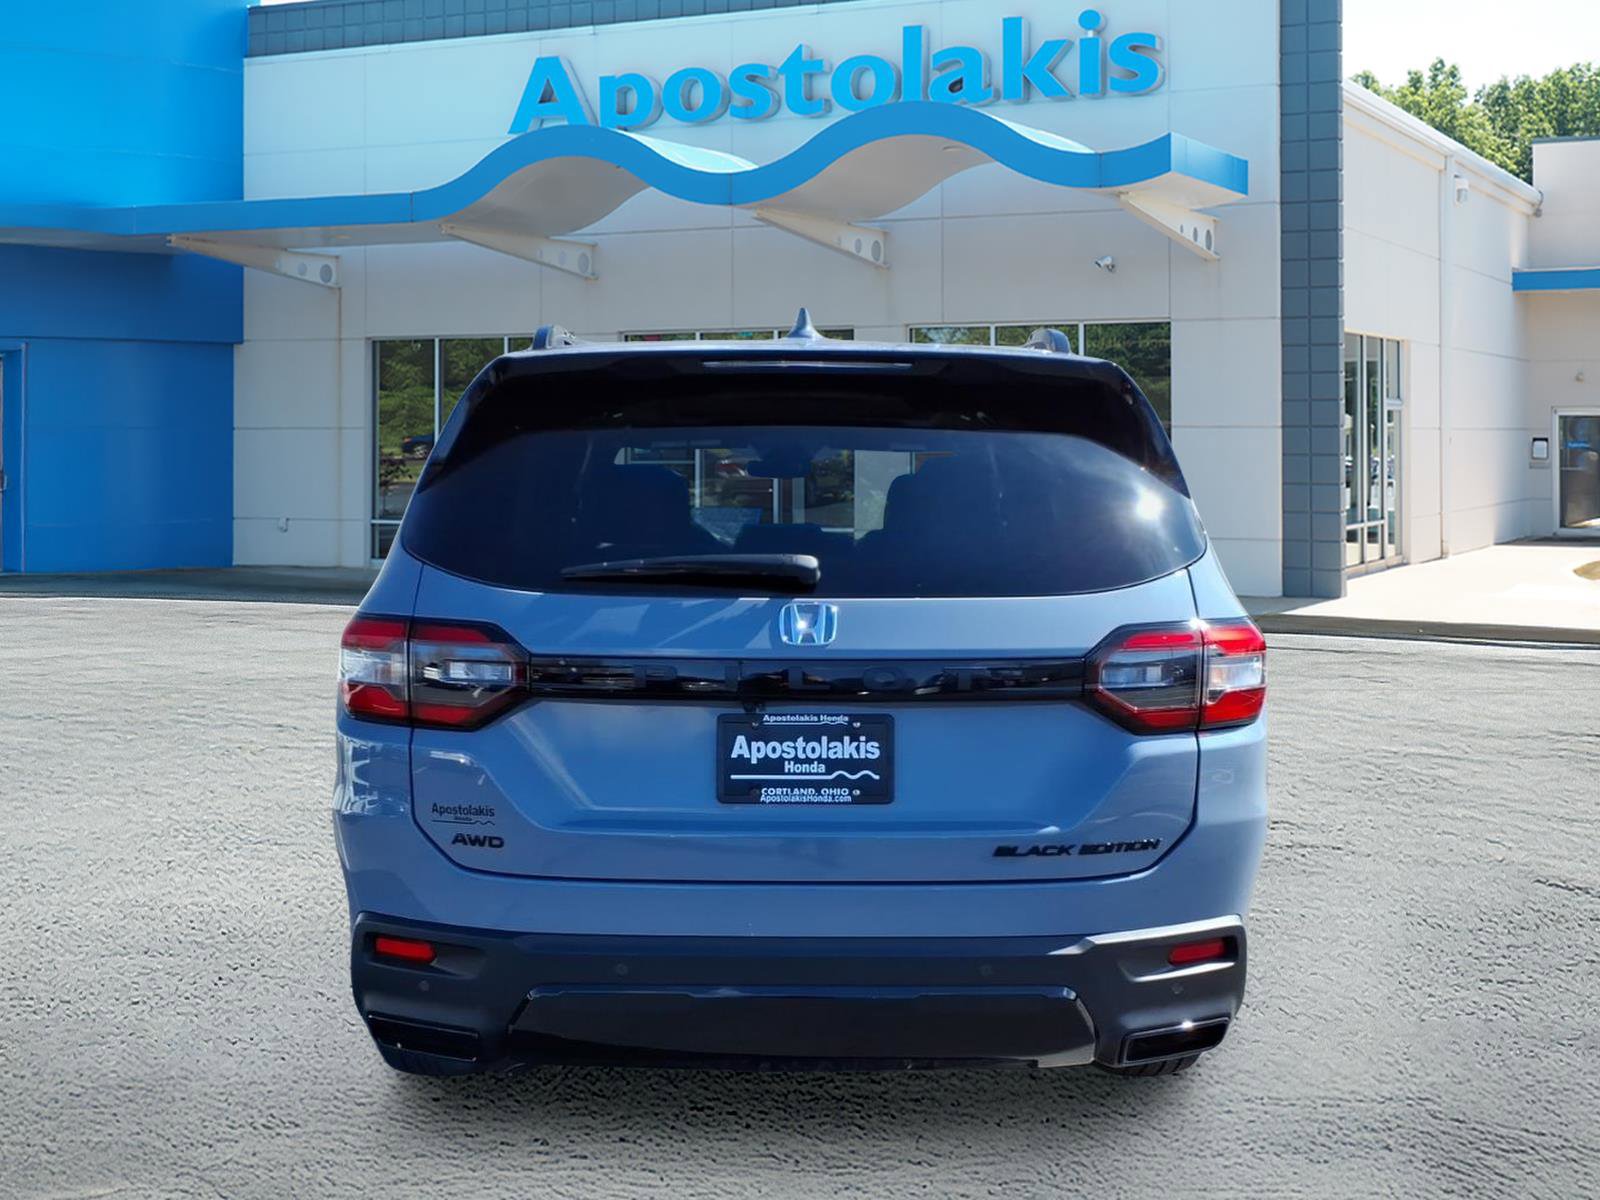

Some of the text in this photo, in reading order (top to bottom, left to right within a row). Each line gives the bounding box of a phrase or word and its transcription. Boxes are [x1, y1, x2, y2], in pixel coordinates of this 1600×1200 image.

[507, 8, 1164, 133] Apostolakis
[763, 714, 849, 723] Apostolakis Honda
[731, 735, 881, 764] Apostolakis
[784, 761, 826, 773] Honda
[760, 795, 852, 803] ApostolakisHonda.com
[432, 802, 495, 817] Apostolakis
[452, 833, 504, 848] AWD
[992, 839, 1162, 857] BLACK EDITION
